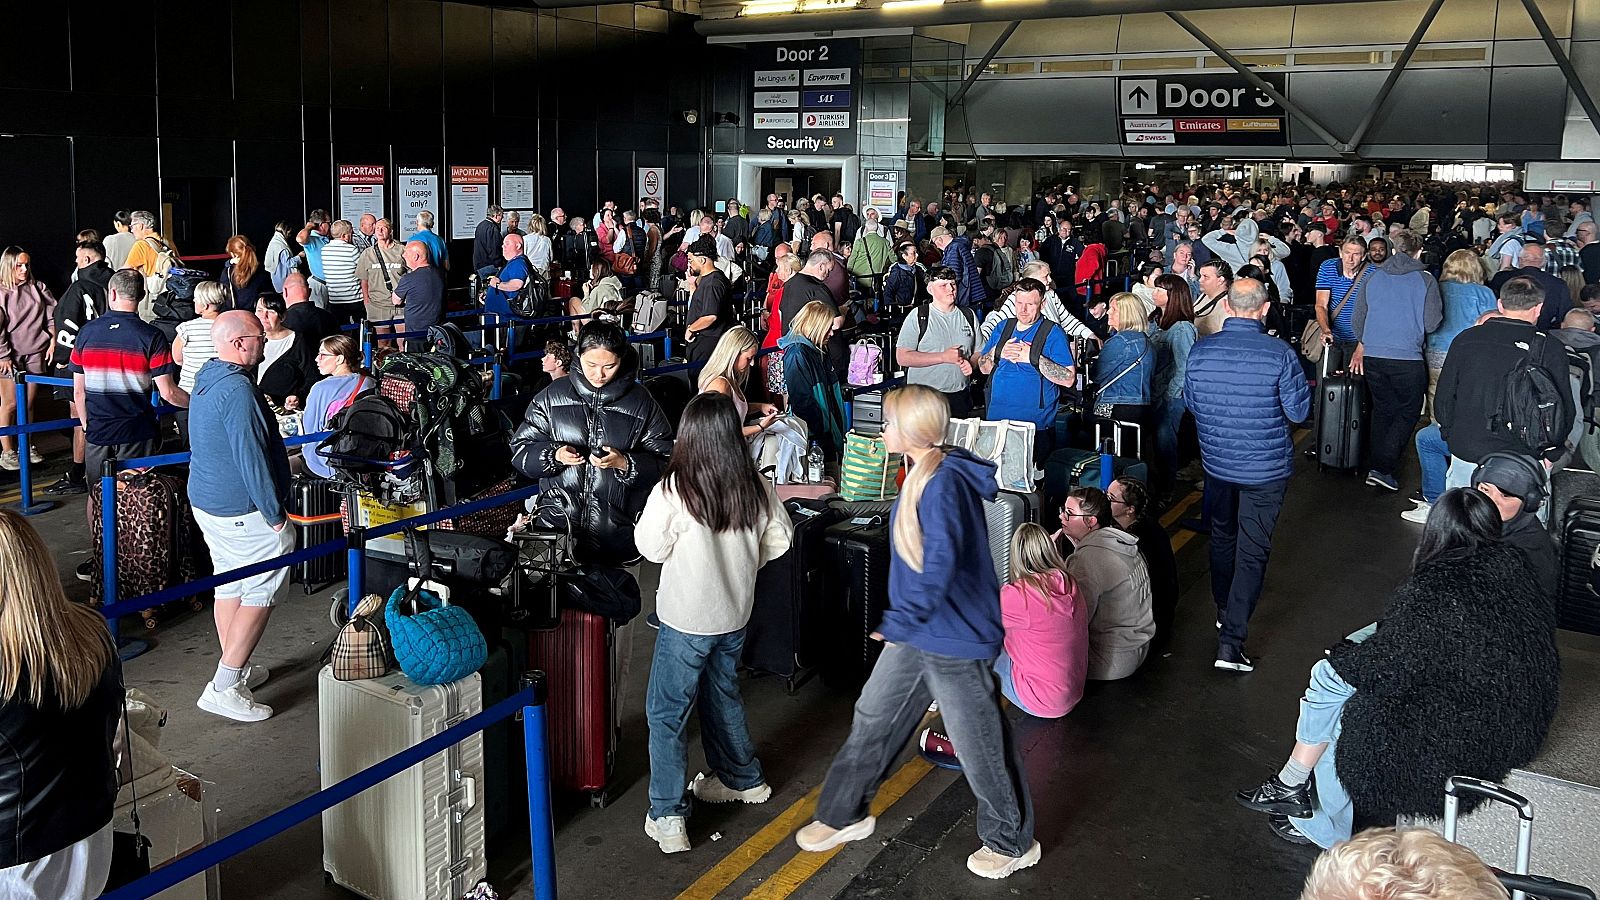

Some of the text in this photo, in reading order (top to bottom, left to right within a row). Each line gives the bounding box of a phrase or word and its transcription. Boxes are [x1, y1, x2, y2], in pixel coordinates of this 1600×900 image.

[776, 45, 829, 62] Door 2
[817, 94, 835, 103] SAS
[1165, 81, 1275, 108] Door 3
[1179, 121, 1221, 130] Emirates
[766, 135, 821, 152] Security
[340, 166, 384, 176] IMPORTANT
[398, 166, 433, 174] Information
[451, 168, 488, 176] IMPORTANT
[409, 178, 428, 186] Hand
[405, 189, 432, 198] luggage
[410, 199, 428, 209] only?
